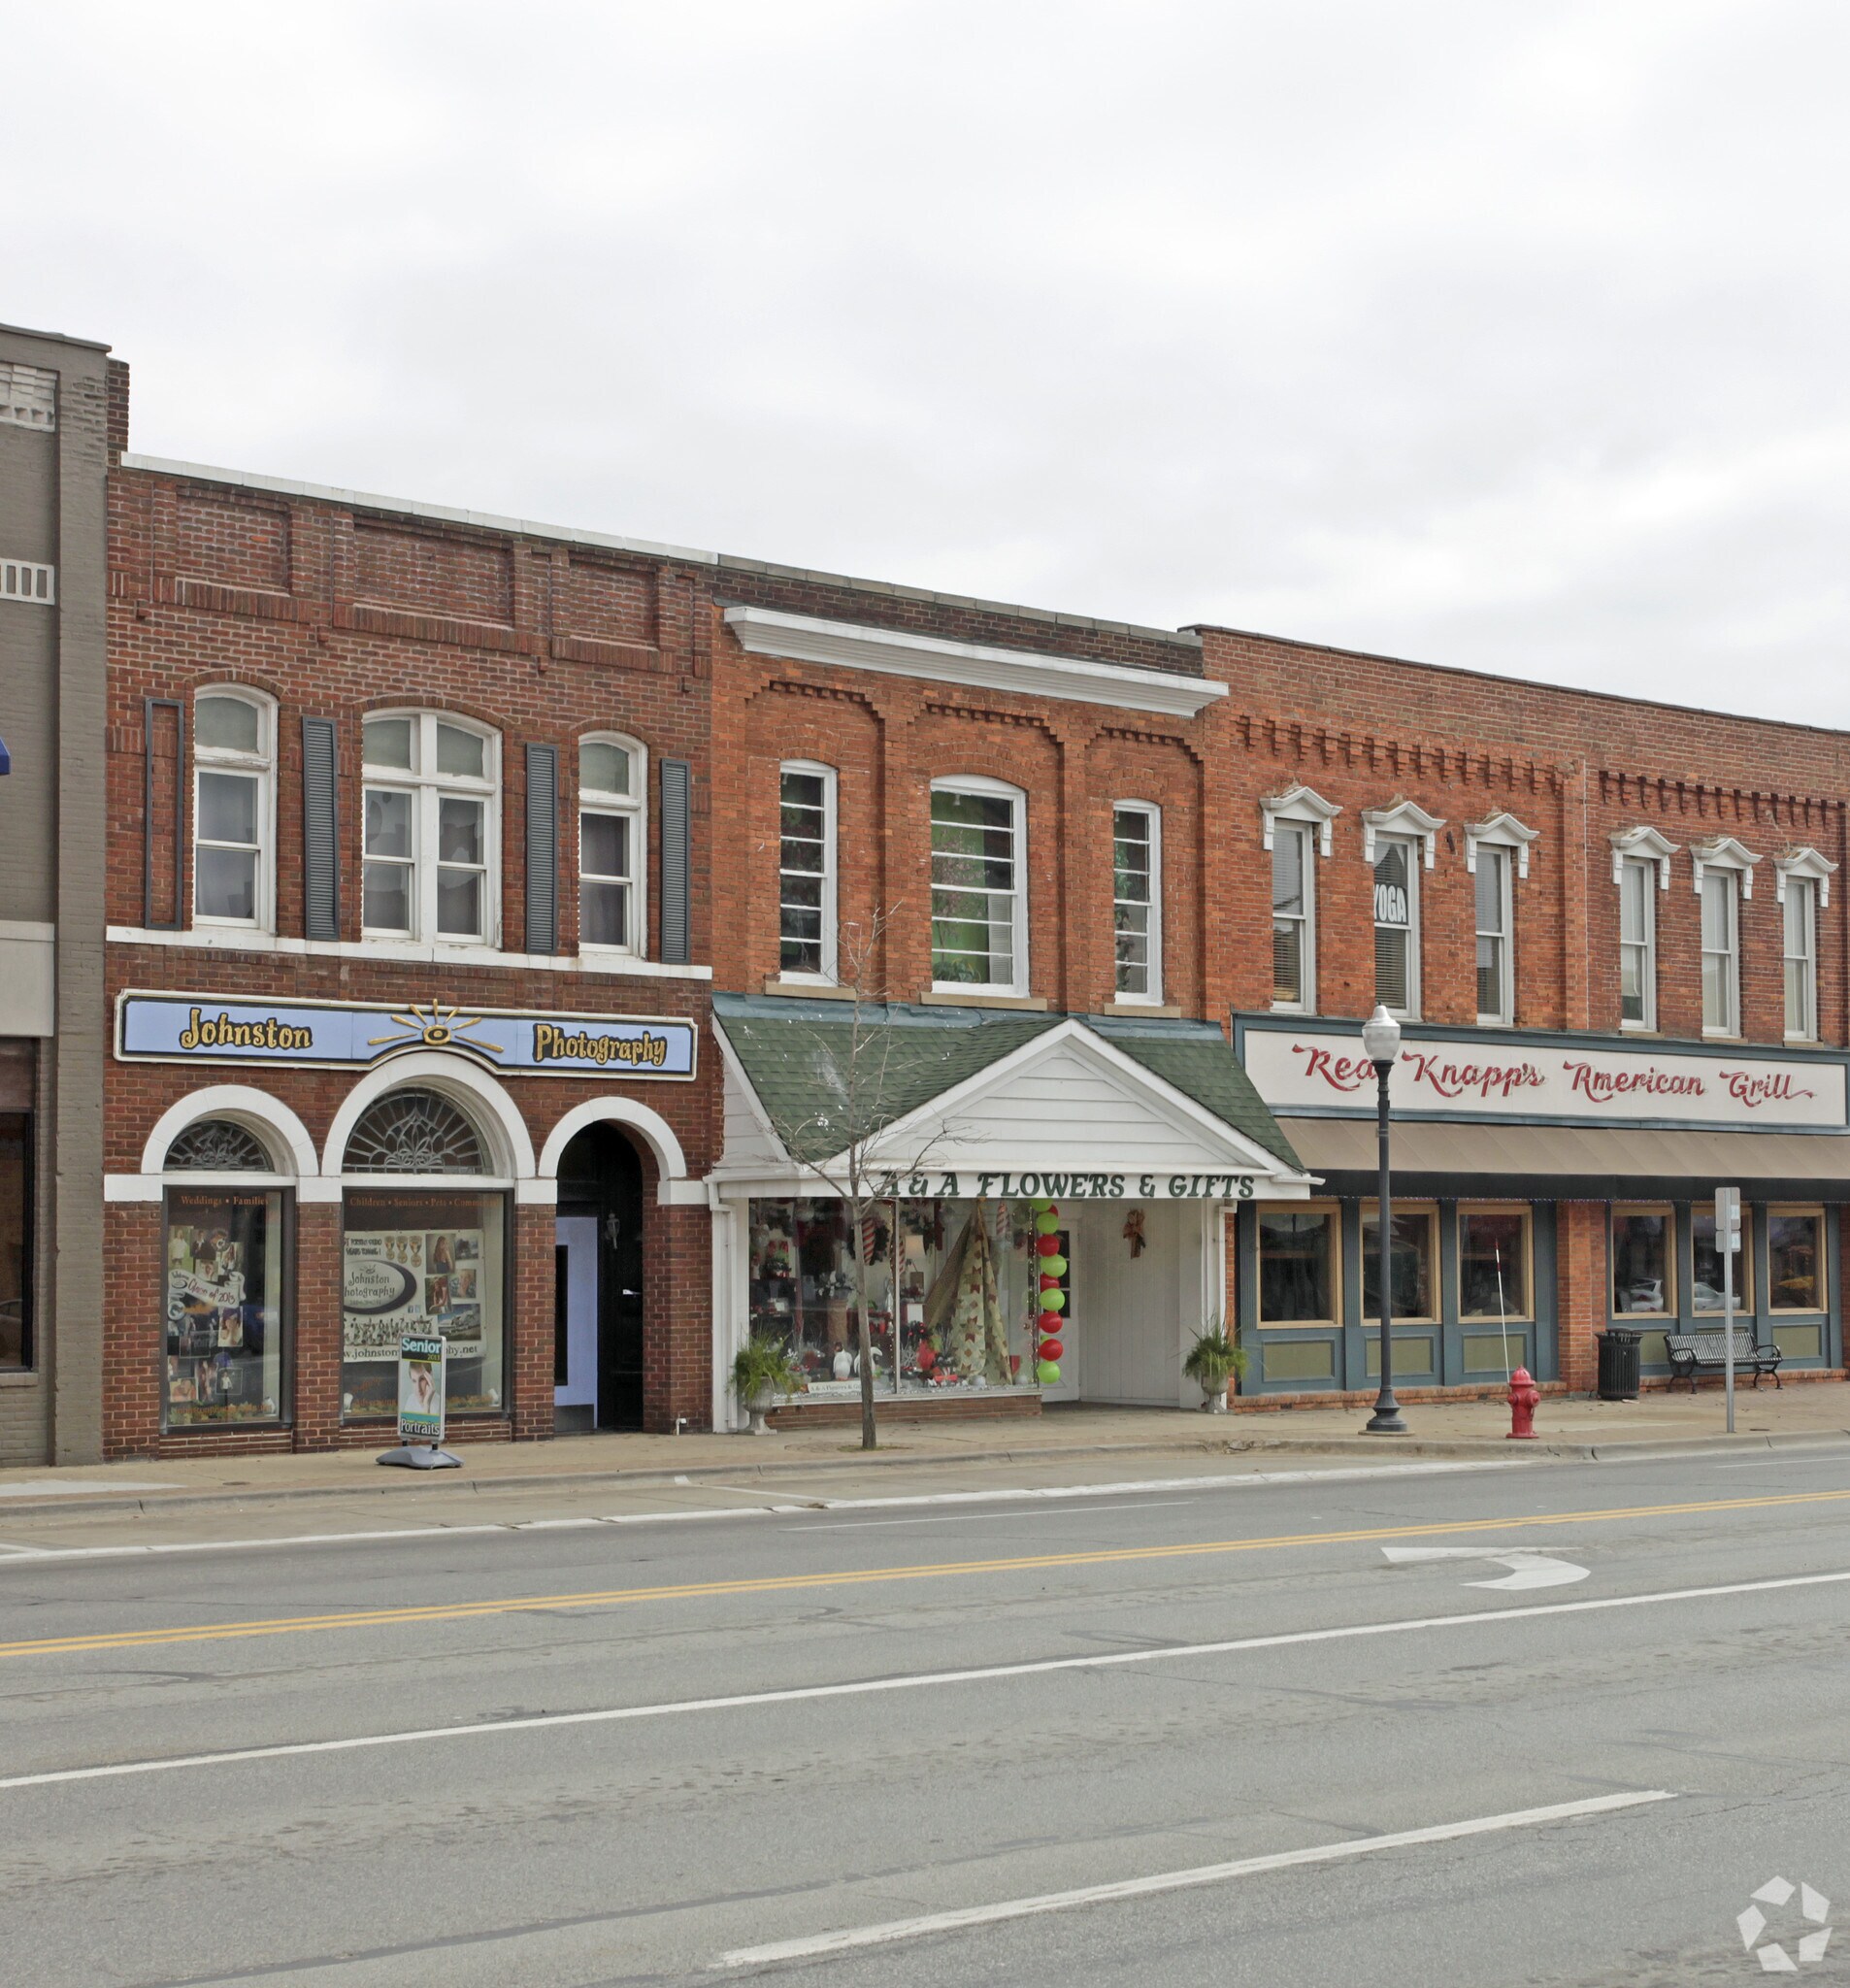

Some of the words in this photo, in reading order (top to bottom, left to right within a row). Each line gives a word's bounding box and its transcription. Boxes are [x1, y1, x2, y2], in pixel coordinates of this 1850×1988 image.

[1373, 884, 1406, 922] YOGA
[181, 1008, 312, 1049] Johnston
[533, 1023, 667, 1066] Photography
[1402, 1049, 1545, 1097] Knapp's
[1563, 1061, 1705, 1103] American
[1720, 1071, 1816, 1108] Grill
[877, 1171, 901, 1195] A
[908, 1172, 929, 1196] &
[934, 1172, 960, 1196] A
[977, 1173, 1125, 1198] FLOWERS
[1140, 1175, 1155, 1197] &
[1169, 1175, 1254, 1198] GIFTS
[181, 1196, 223, 1208] Weddings
[348, 1272, 390, 1286] Johnston
[344, 1285, 395, 1298] hotography
[402, 1338, 442, 1353] Senior
[401, 1418, 440, 1436] Portraits
